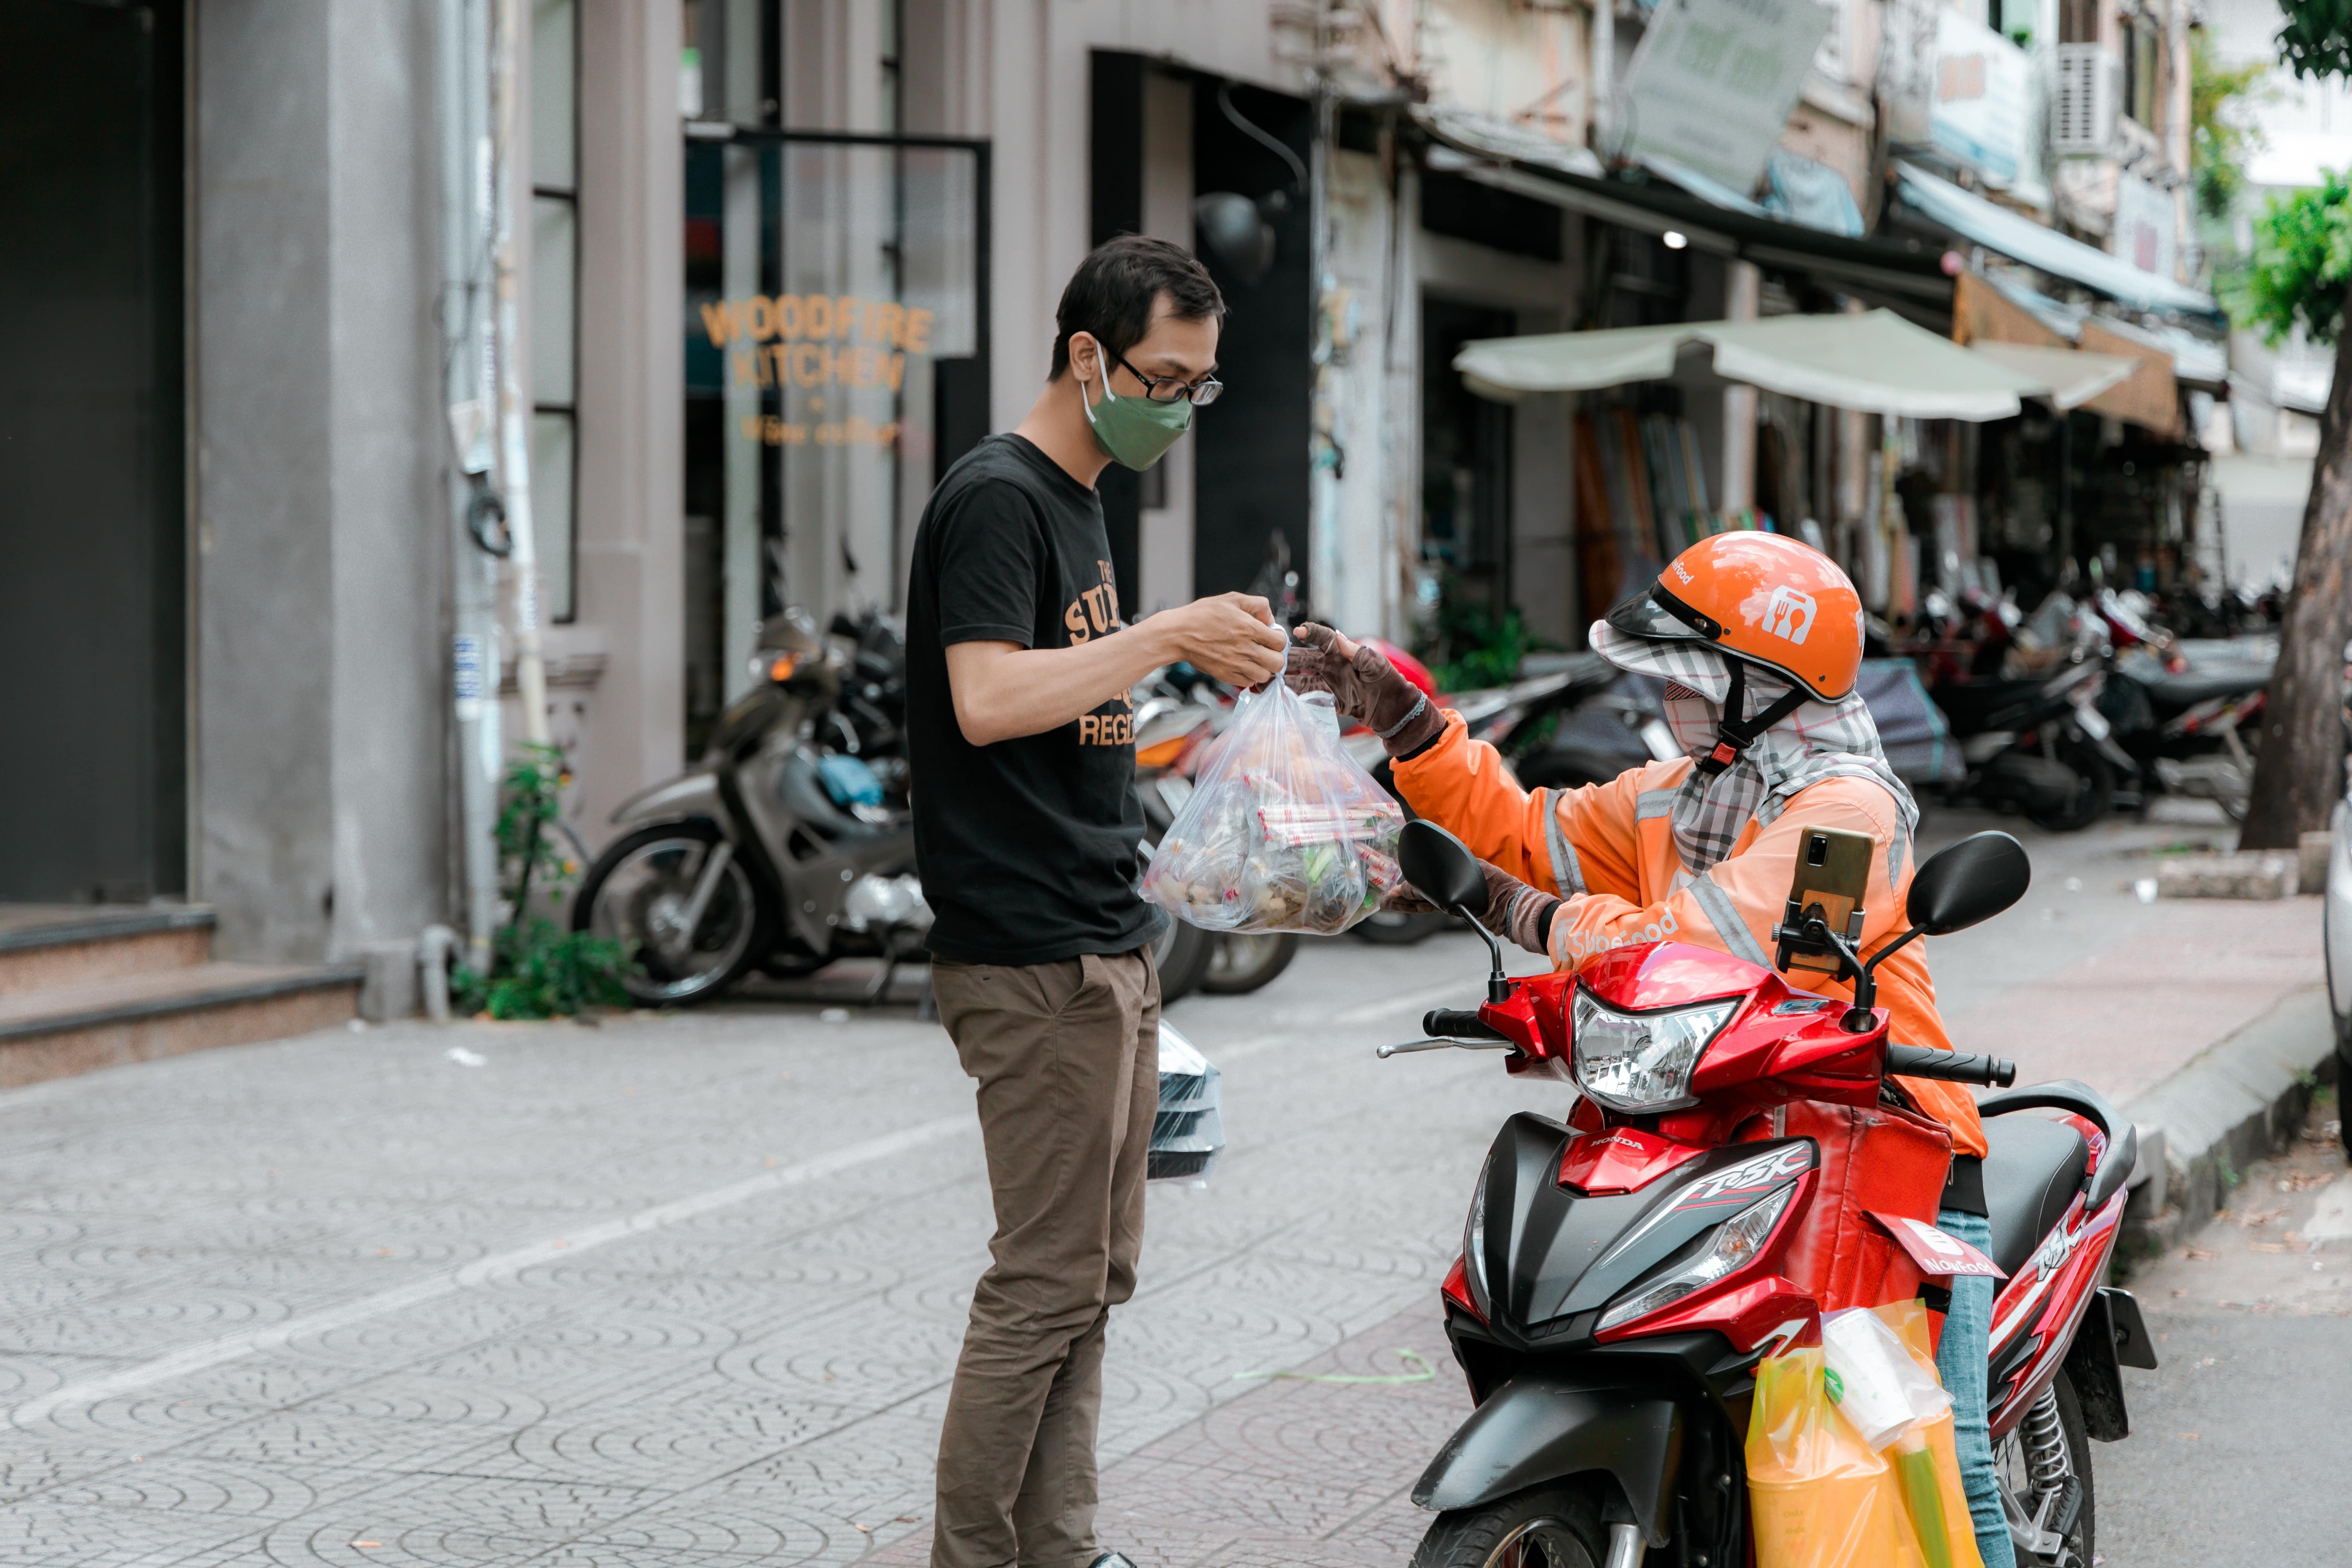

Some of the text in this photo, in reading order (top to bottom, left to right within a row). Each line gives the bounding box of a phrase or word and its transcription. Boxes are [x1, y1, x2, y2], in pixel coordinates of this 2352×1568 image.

[701, 294, 935, 354] WOODFIRE
[732, 343, 905, 394] KITCHEN
[1590, 1136, 1644, 1150] HONDA
